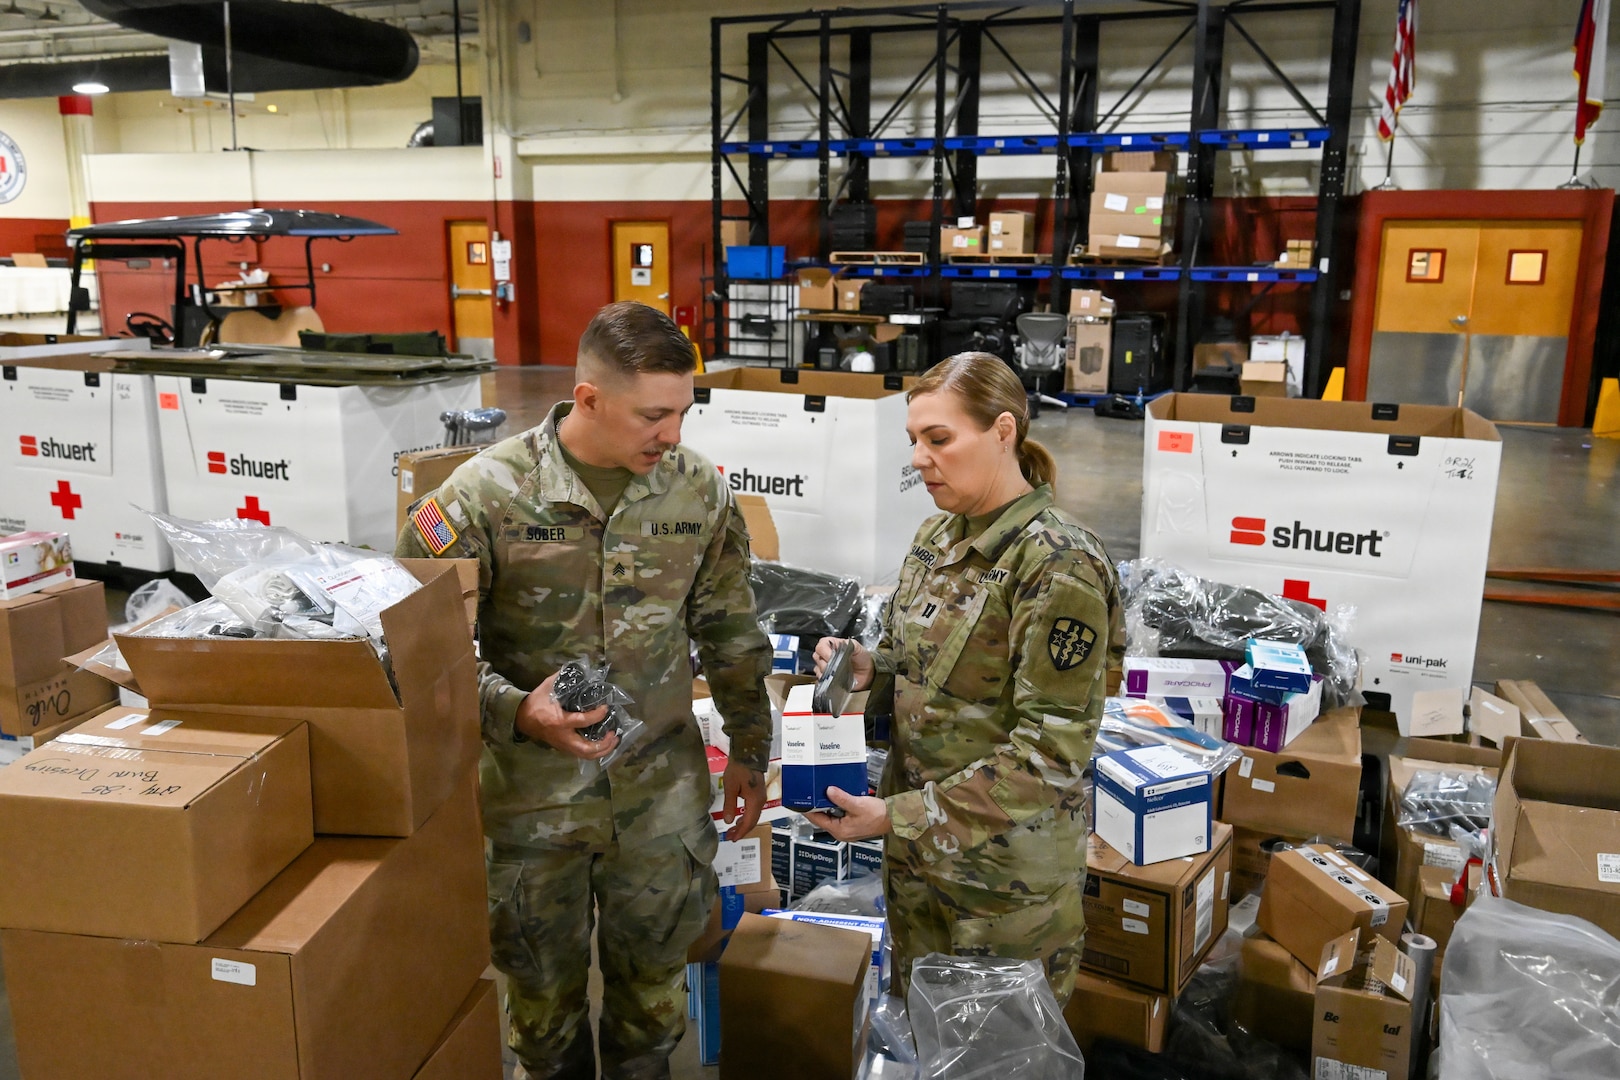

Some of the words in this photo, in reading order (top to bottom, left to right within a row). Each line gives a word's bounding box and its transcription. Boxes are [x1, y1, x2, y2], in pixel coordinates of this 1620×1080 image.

[41, 437, 96, 462] shuert
[230, 454, 290, 480] shuert
[729, 468, 804, 497] shuert
[526, 527, 566, 541] SOBER
[651, 522, 673, 536] U.S.
[674, 522, 702, 535] ARMY
[1272, 520, 1382, 558] shuert
[1405, 654, 1447, 668] uni-pak
[1164, 680, 1212, 688] PROCARE
[26, 690, 70, 727] Ovik
[1234, 703, 1242, 738] PROCARE
[1263, 710, 1272, 746] PROCARE
[820, 742, 840, 750] Vaseline
[805, 850, 834, 864] DripDrop
[1324, 1012, 1339, 1024] Be
